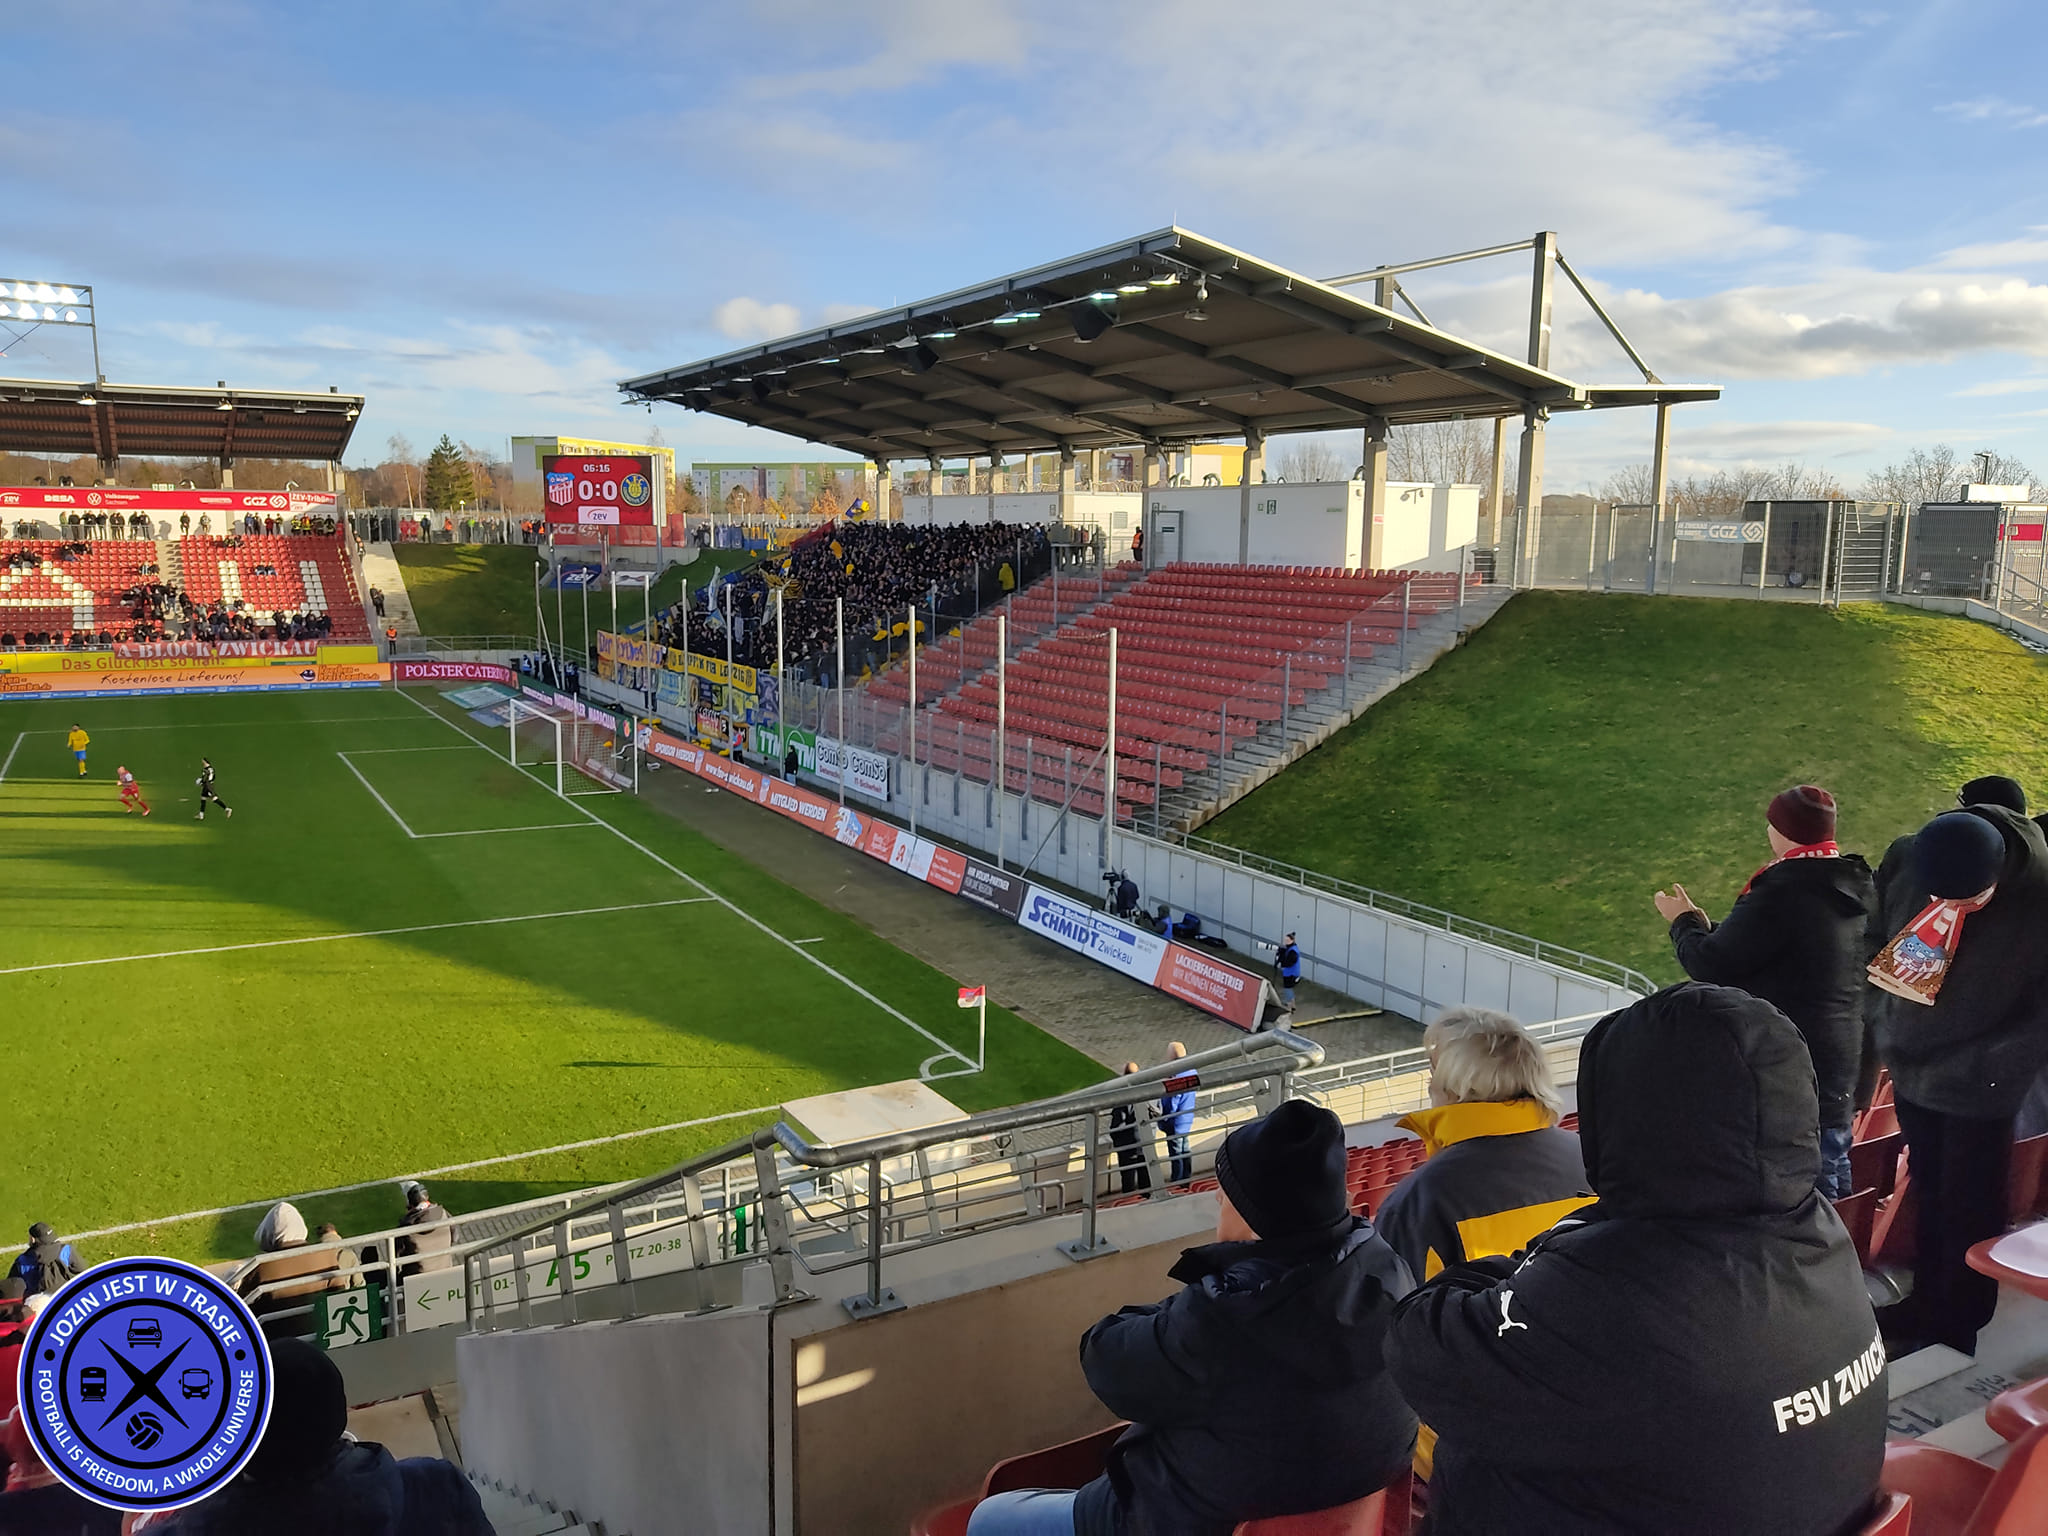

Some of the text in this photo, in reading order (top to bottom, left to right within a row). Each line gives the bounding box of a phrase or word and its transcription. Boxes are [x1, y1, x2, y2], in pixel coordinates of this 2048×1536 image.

[578, 480, 618, 500] 0:0
[1708, 525, 1738, 539] GGZ
[117, 640, 318, 658] A-BLOCK ZWICKAU
[62, 658, 91, 671] Das
[170, 656, 187, 667] so
[405, 664, 464, 678] POLSTER
[101, 670, 245, 685] Kostenlose Lieferung!
[817, 741, 848, 770] Como
[851, 752, 886, 782] ComSo
[770, 792, 827, 821] MITGLIED WERDEN
[1028, 895, 1099, 948] SCHMIDT
[1095, 919, 1120, 939] GmbH
[1098, 939, 1133, 965] Zwickau
[1175, 953, 1244, 992] LACKIERFACHBETRIEB
[647, 1238, 682, 1256] 20-38
[1772, 1379, 1831, 1434] FSV
